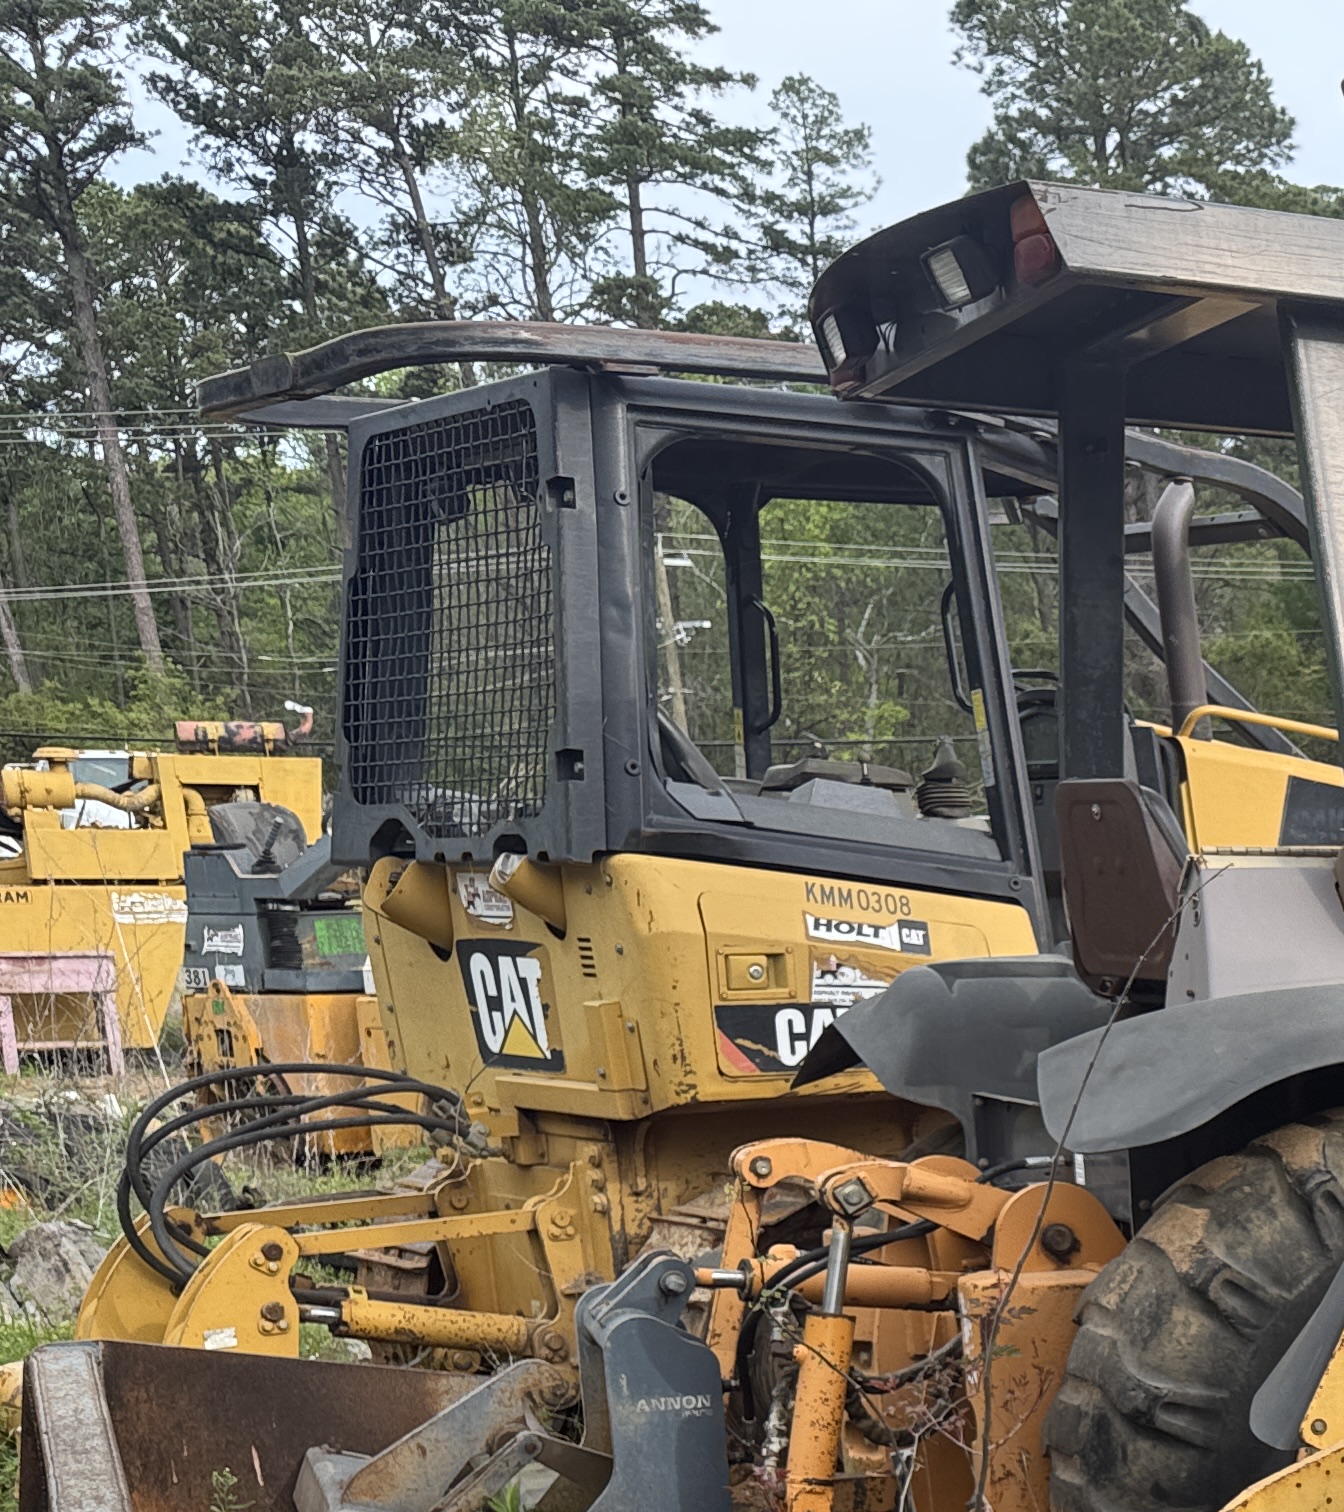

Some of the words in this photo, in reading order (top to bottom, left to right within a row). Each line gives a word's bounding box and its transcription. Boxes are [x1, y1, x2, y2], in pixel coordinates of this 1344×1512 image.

[0, 891, 29, 904] AM
[804, 881, 912, 917] KMM0308
[812, 917, 888, 940] HOLT
[900, 927, 927, 946] CAT
[469, 951, 552, 1061] CAT
[774, 1007, 849, 1067] CA
